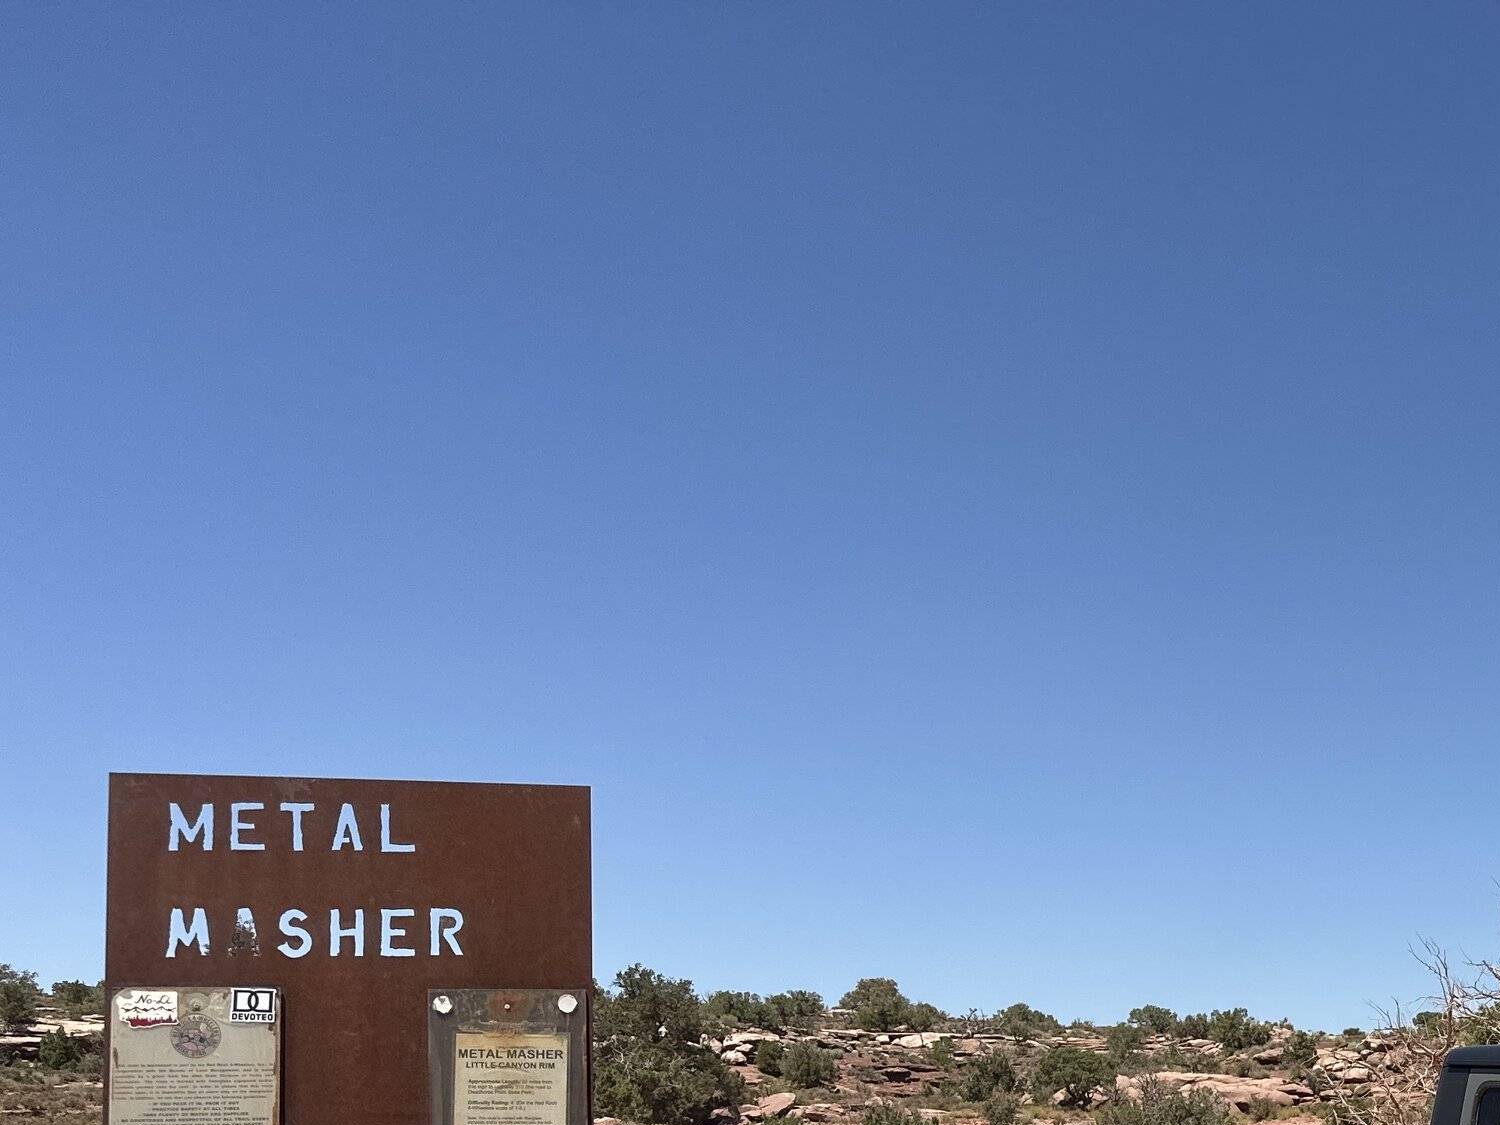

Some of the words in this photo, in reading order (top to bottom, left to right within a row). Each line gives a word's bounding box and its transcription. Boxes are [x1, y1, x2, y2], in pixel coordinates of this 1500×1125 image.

[168, 802, 416, 852] METAL
[165, 908, 464, 957] MASHER
[458, 1049, 503, 1058] METAL
[506, 1049, 563, 1059] MASHER
